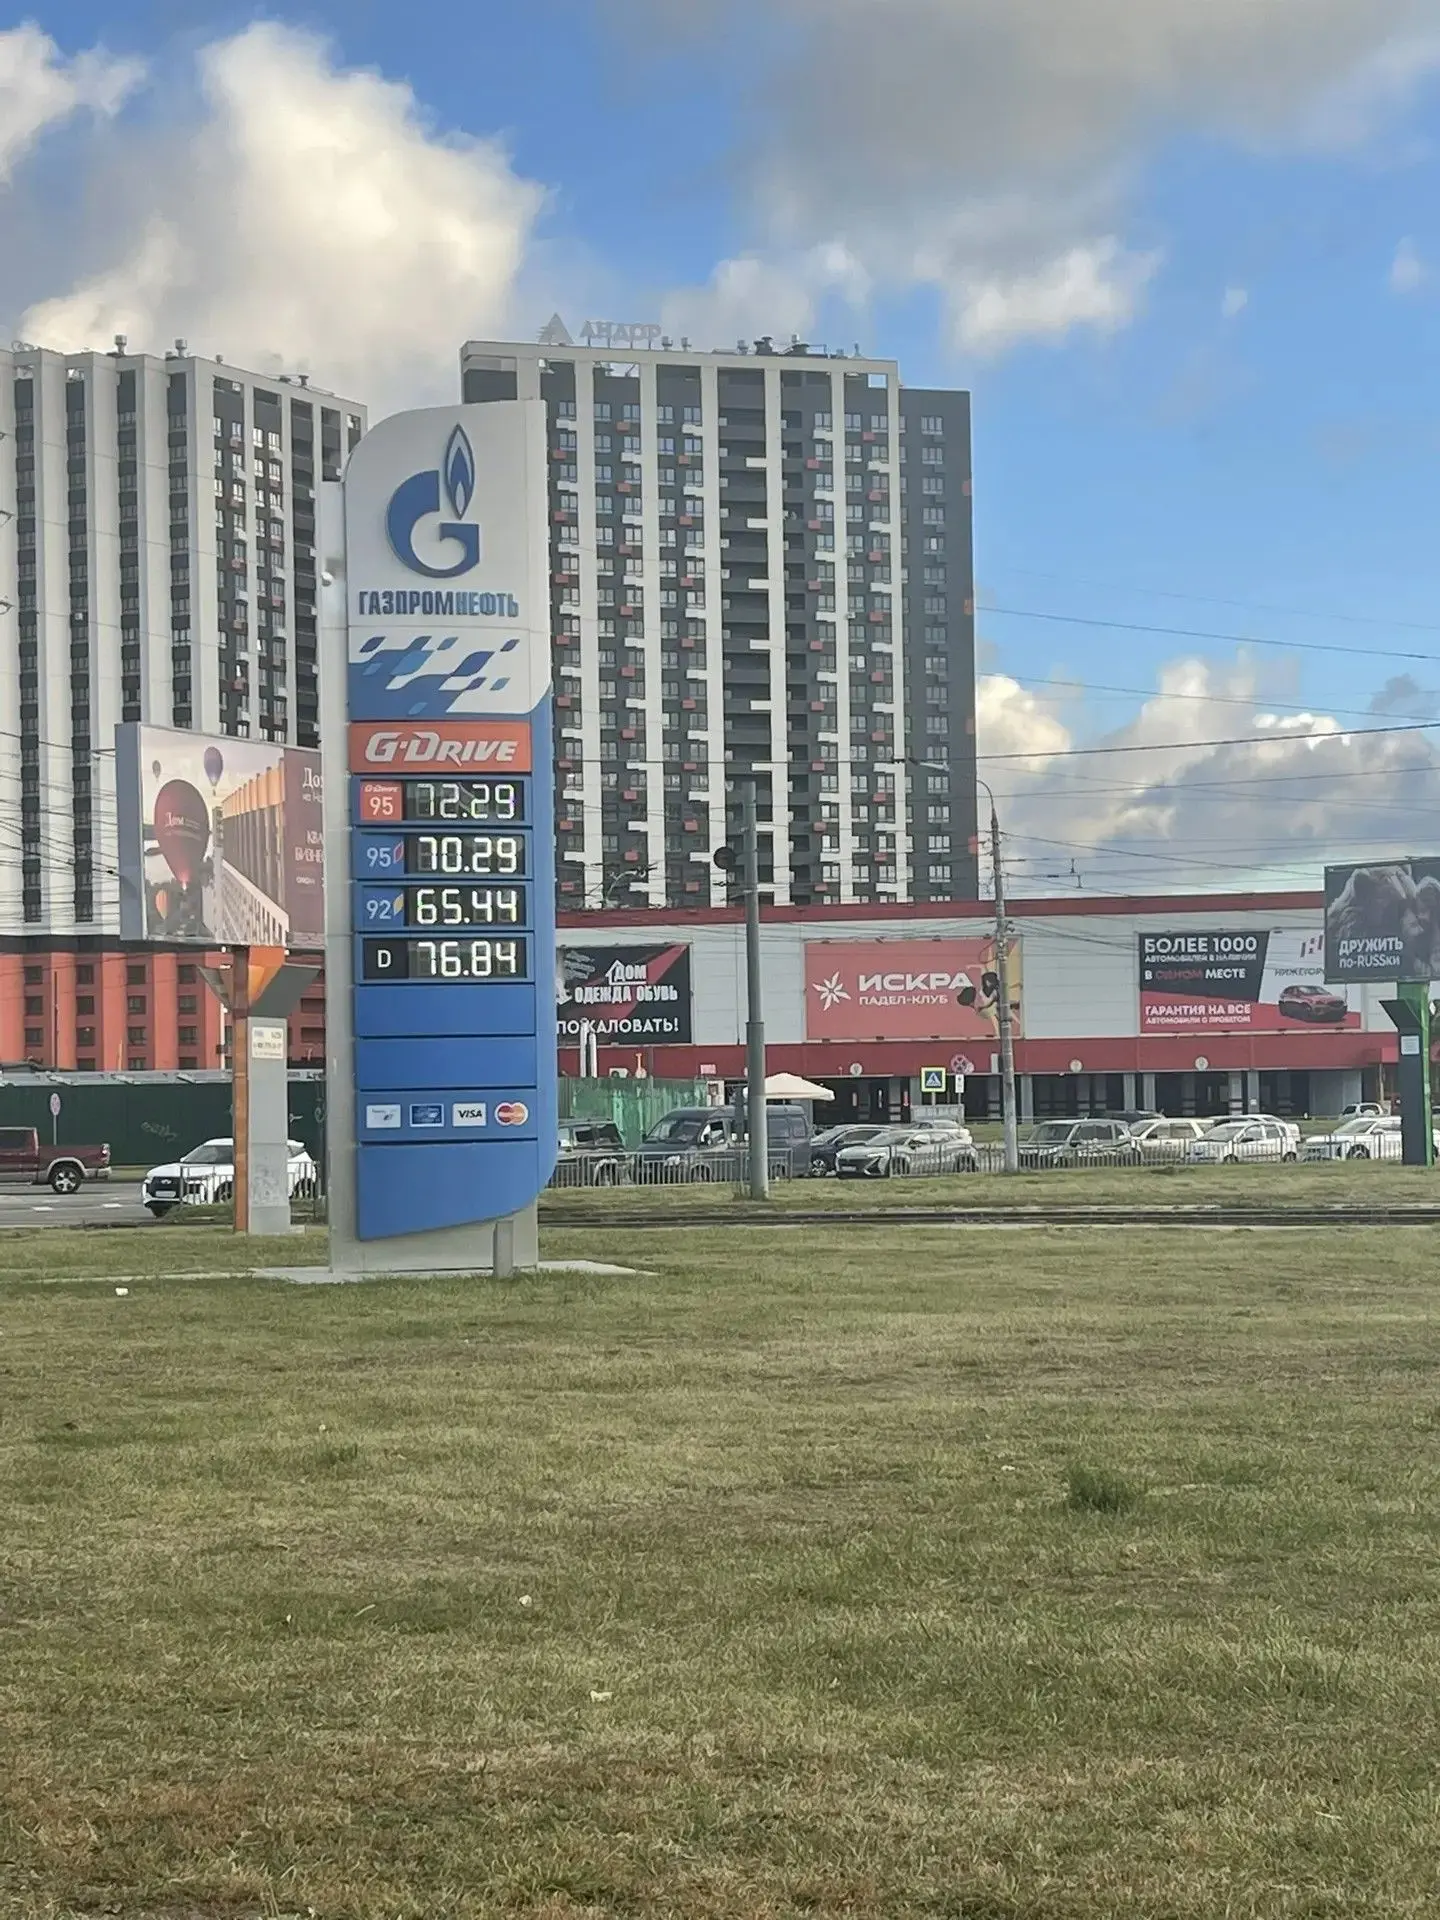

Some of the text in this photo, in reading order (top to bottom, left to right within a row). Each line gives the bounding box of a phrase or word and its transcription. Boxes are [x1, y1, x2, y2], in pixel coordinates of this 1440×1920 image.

[359, 590, 519, 617] ГАЗПРОМНЕФТЬ
[370, 783, 515, 819] 95 72.29
[366, 836, 517, 873] 95 70.29
[366, 889, 517, 924] 92 65.44
[1144, 936, 1257, 953] БОЛЕЕ 1000
[1339, 937, 1404, 956] ДРУЖИТЬ
[377, 941, 517, 977] D 76.84
[859, 972, 973, 991] ИСКРА
[1144, 970, 1153, 980] В
[1205, 968, 1246, 979] МЕСТЕ
[574, 985, 678, 1004] ОДЕЖДА ОБУВЬ
[859, 994, 948, 1006] ПАДЕЛ-КЛУБ
[1145, 1004, 1251, 1016] ГАРАНТИЯ НА ВСЕ
[458, 1109, 482, 1120] VISA
